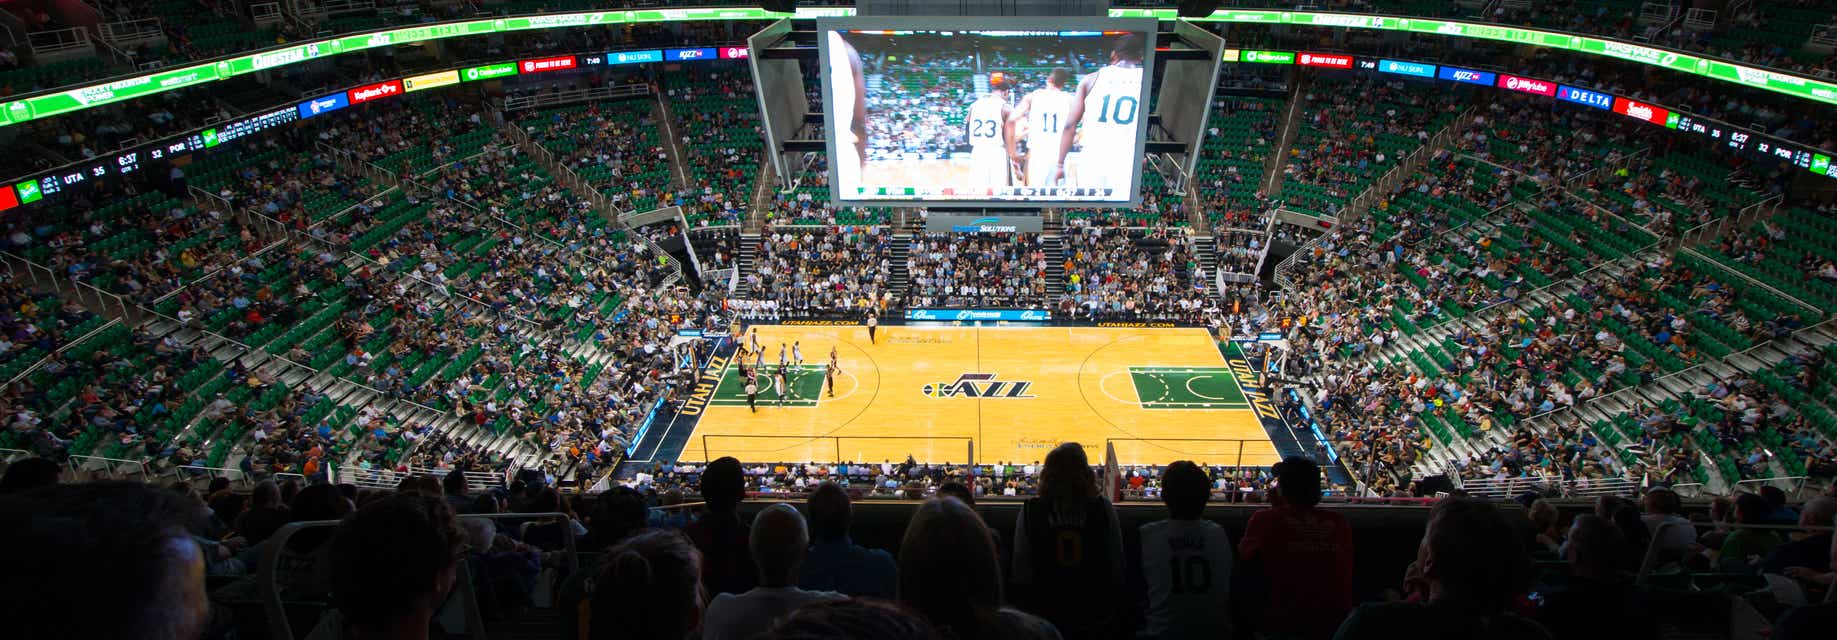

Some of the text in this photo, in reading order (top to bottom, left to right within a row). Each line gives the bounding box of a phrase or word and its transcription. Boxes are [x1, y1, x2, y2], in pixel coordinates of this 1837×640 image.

[252, 48, 305, 69] QUESTAR
[1098, 95, 1138, 125] 10
[1571, 90, 1609, 107] DELTA
[973, 118, 997, 138] 23
[1042, 112, 1058, 133] 11
[1692, 123, 1706, 134] UTA
[1731, 132, 1749, 144] 6:37
[151, 149, 163, 160] 32
[169, 142, 186, 154] POR
[1758, 143, 1793, 159] 32 POR
[63, 152, 137, 185] UTA 35 6:37
[681, 383, 715, 416] UTAH
[701, 355, 729, 382] JAZZ
[922, 373, 1039, 400] JAZZ
[1229, 359, 1261, 389] UTAH
[1243, 390, 1281, 420] JAZZ
[1056, 529, 1083, 568] 0
[1170, 556, 1211, 595] 10
